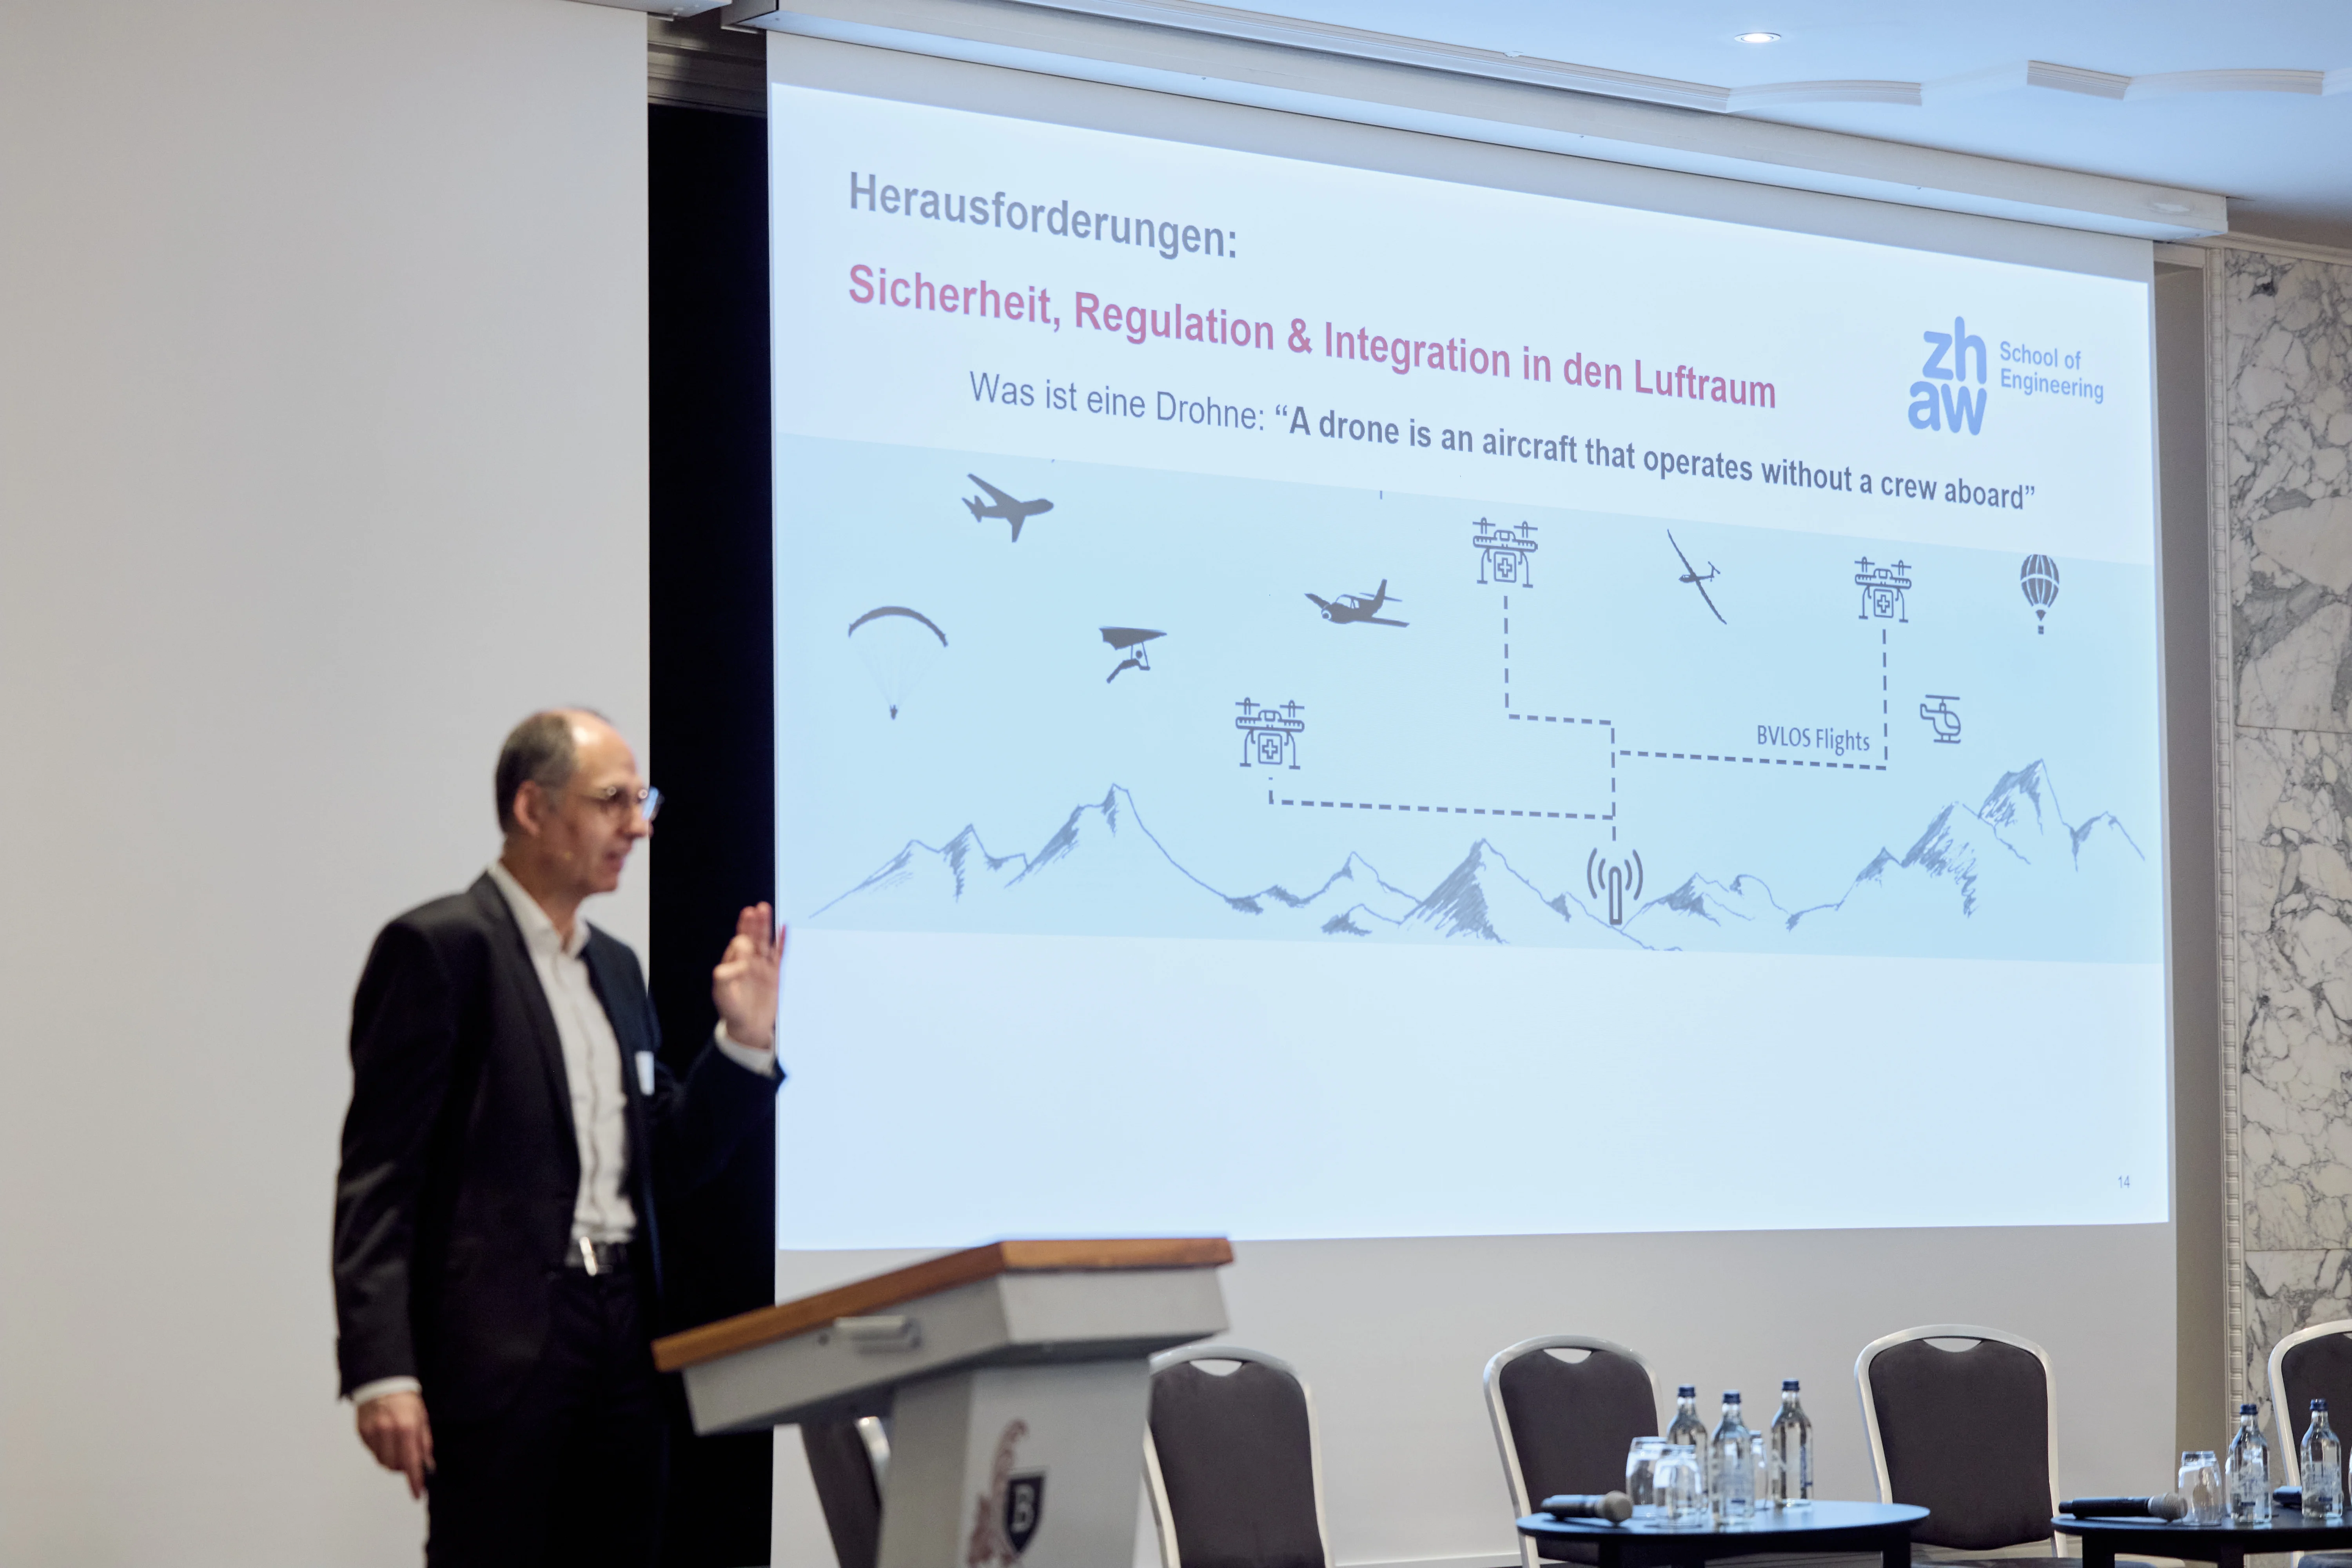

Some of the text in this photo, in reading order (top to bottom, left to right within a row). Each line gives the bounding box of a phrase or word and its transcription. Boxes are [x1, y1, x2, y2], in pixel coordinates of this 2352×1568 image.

[850, 171, 1236, 260] Herausforderungen:
[848, 263, 1776, 409] Sicherheit, Regulation & Integration in den Luftraum
[1922, 316, 1987, 385] zh
[2000, 340, 2082, 370] School of
[1907, 380, 1987, 436] aw
[2001, 368, 2104, 405] Engineering
[969, 370, 2035, 510] Was ist eine Drohne: “A drone is an aircraft that operates without a crew aboard”
[1757, 725, 1870, 756] BVLOS Flights
[2118, 1175, 2130, 1189] 14
[1011, 1483, 1035, 1534] B
